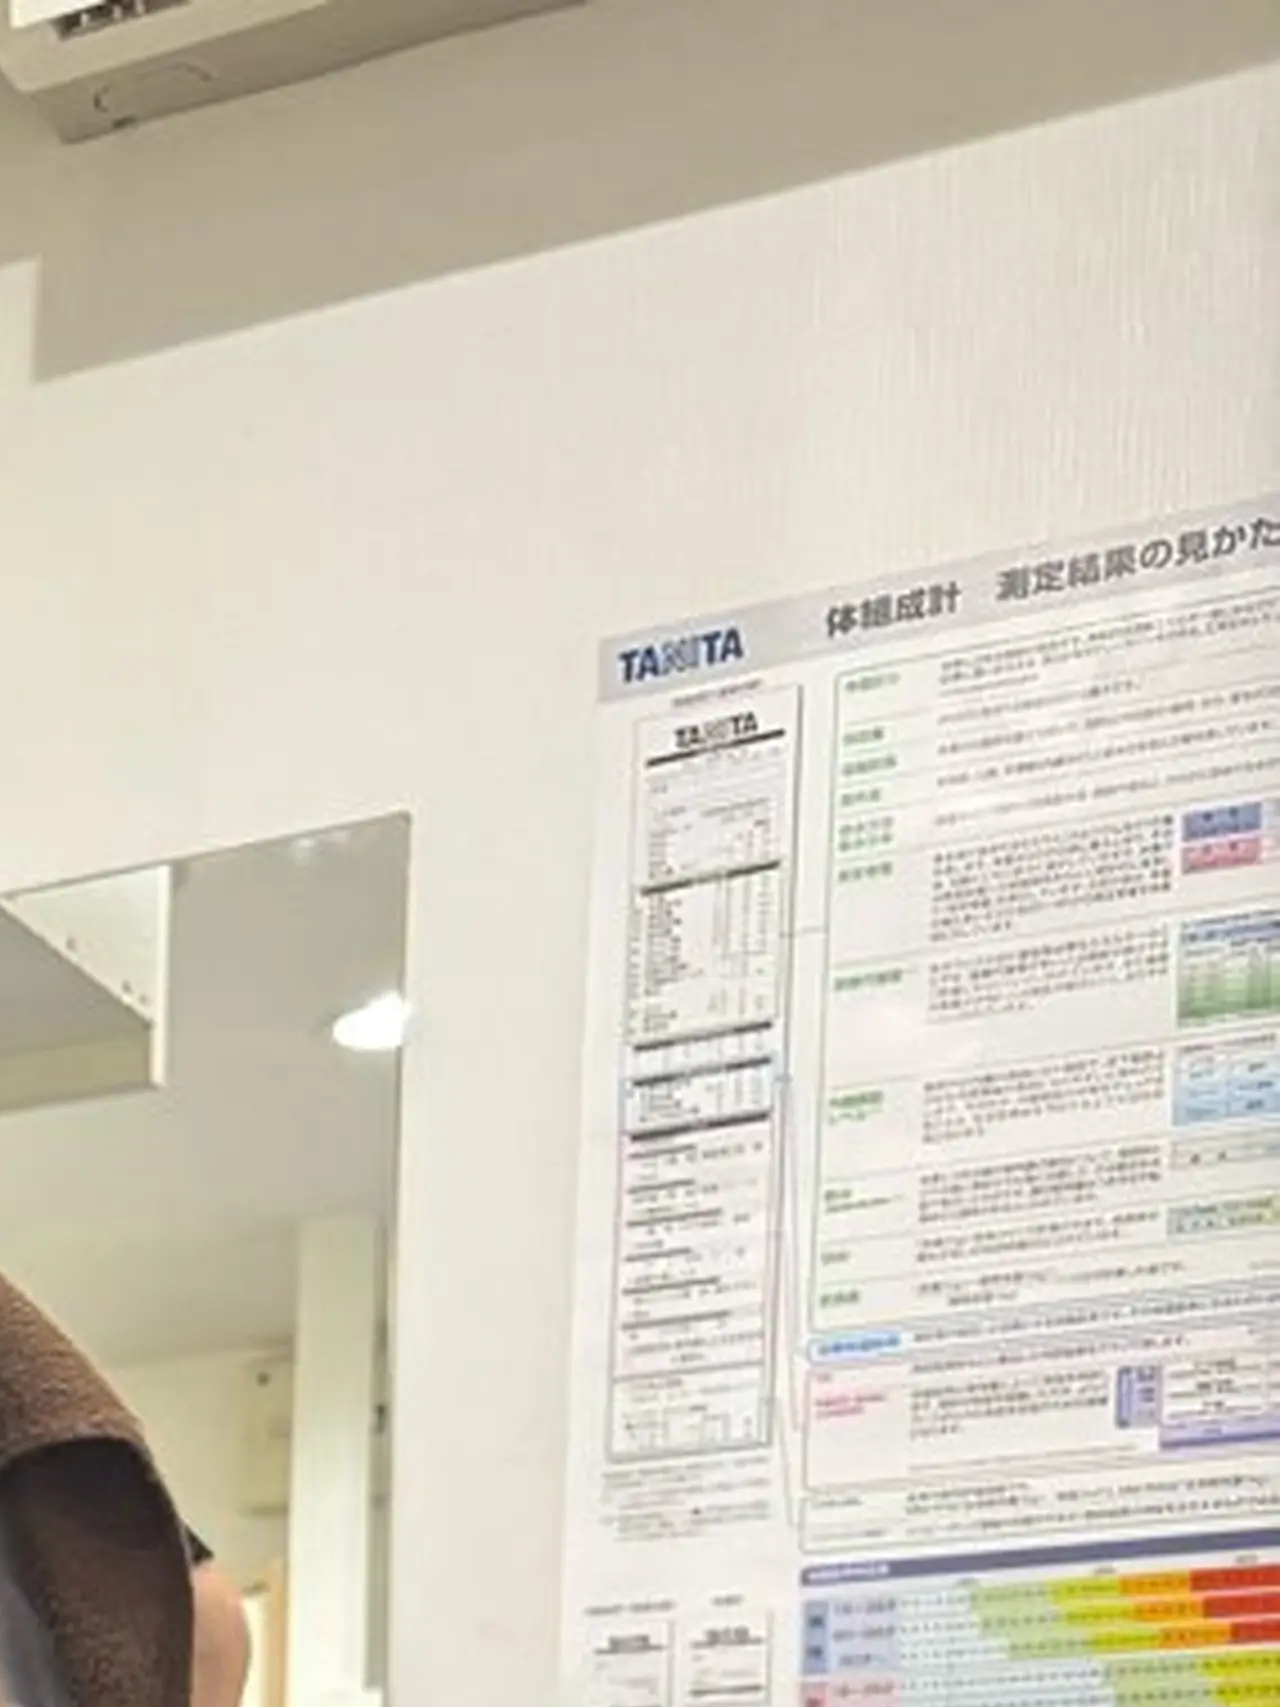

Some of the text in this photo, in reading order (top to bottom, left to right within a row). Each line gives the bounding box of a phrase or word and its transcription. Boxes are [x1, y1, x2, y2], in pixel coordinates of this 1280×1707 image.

[996, 516, 1280, 601] 測定結果の見かた
[617, 627, 744, 684] TANITA
